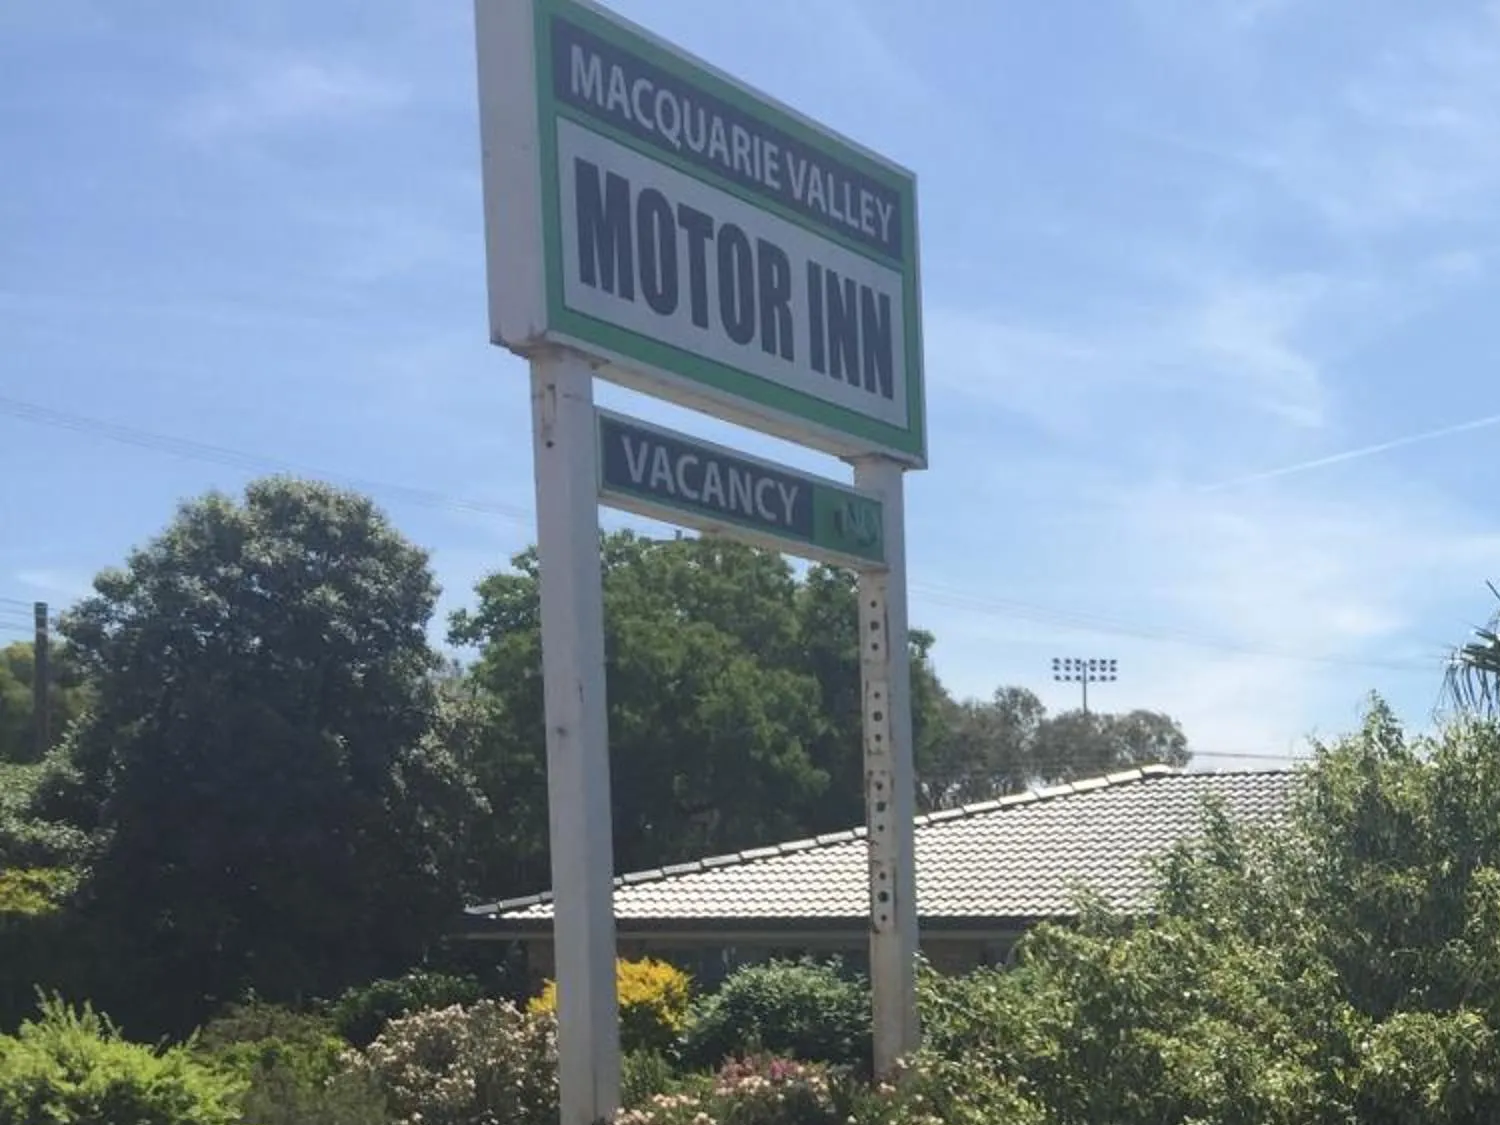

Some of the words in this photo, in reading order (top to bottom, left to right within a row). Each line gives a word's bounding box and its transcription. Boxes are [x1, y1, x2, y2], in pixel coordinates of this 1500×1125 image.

[570, 44, 781, 188] MACQUARIE
[786, 151, 895, 243] VALLEY
[574, 157, 795, 362] MOTOR
[807, 260, 894, 400] INN
[621, 436, 799, 526] VACANCY
